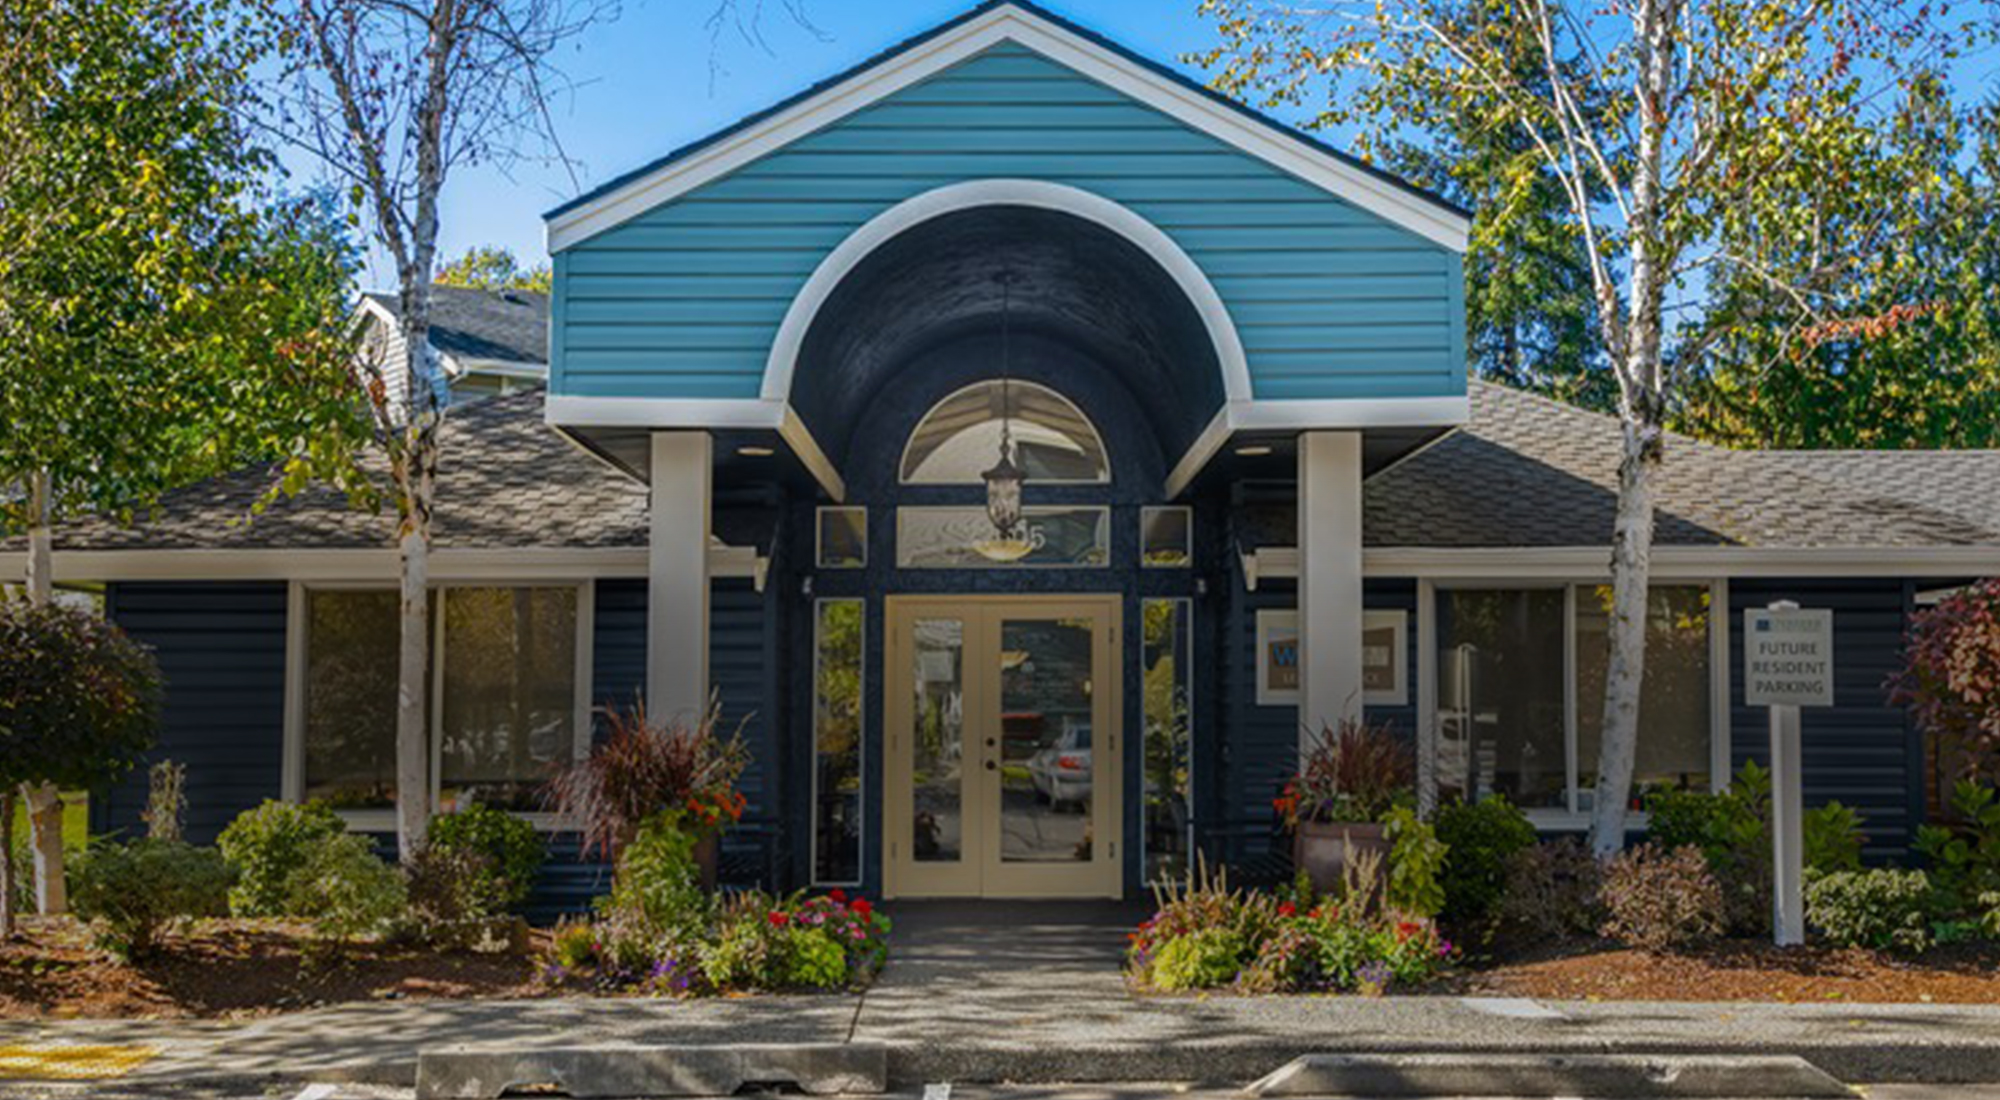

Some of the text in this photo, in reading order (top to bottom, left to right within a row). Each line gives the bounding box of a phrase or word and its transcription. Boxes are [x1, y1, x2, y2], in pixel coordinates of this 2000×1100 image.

[1760, 642, 1817, 655] FUTURE
[1752, 661, 1826, 674] RESIDENT
[1756, 680, 1824, 695] PARKING
